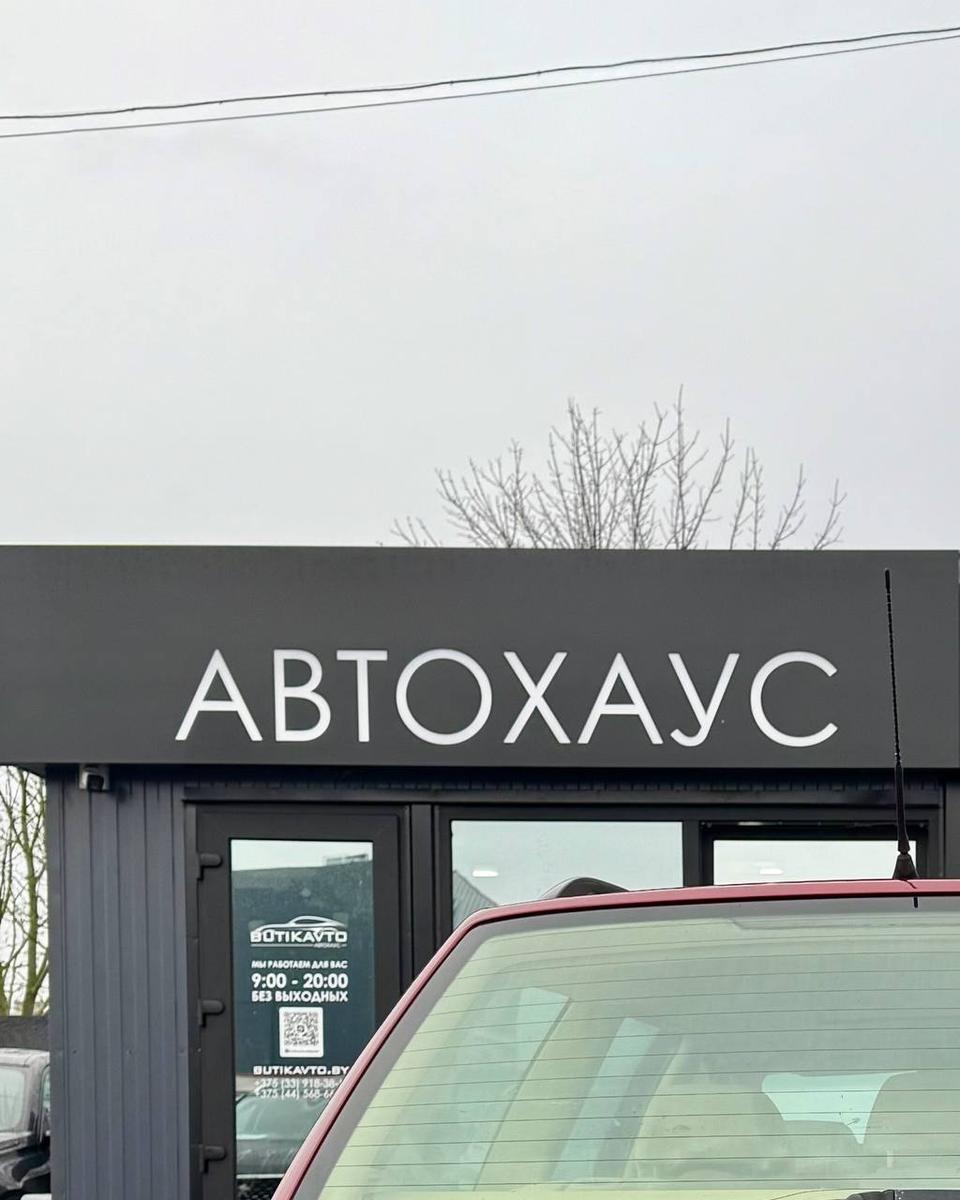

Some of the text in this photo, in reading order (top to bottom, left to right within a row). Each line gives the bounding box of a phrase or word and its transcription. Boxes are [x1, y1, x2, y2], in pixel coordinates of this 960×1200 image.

[175, 649, 839, 748] АВТОХАУС
[250, 930, 348, 943] BUTIKAVTO
[251, 960, 348, 970] МЫ РАБОТАЕМ ДЛЯ ВАС
[251, 972, 287, 989] 9:00
[302, 972, 349, 989] 20:00
[251, 990, 349, 1003] БЕЗ ВЫХОДНЫХ
[253, 1065, 350, 1076] BUTIKAVTO.BY
